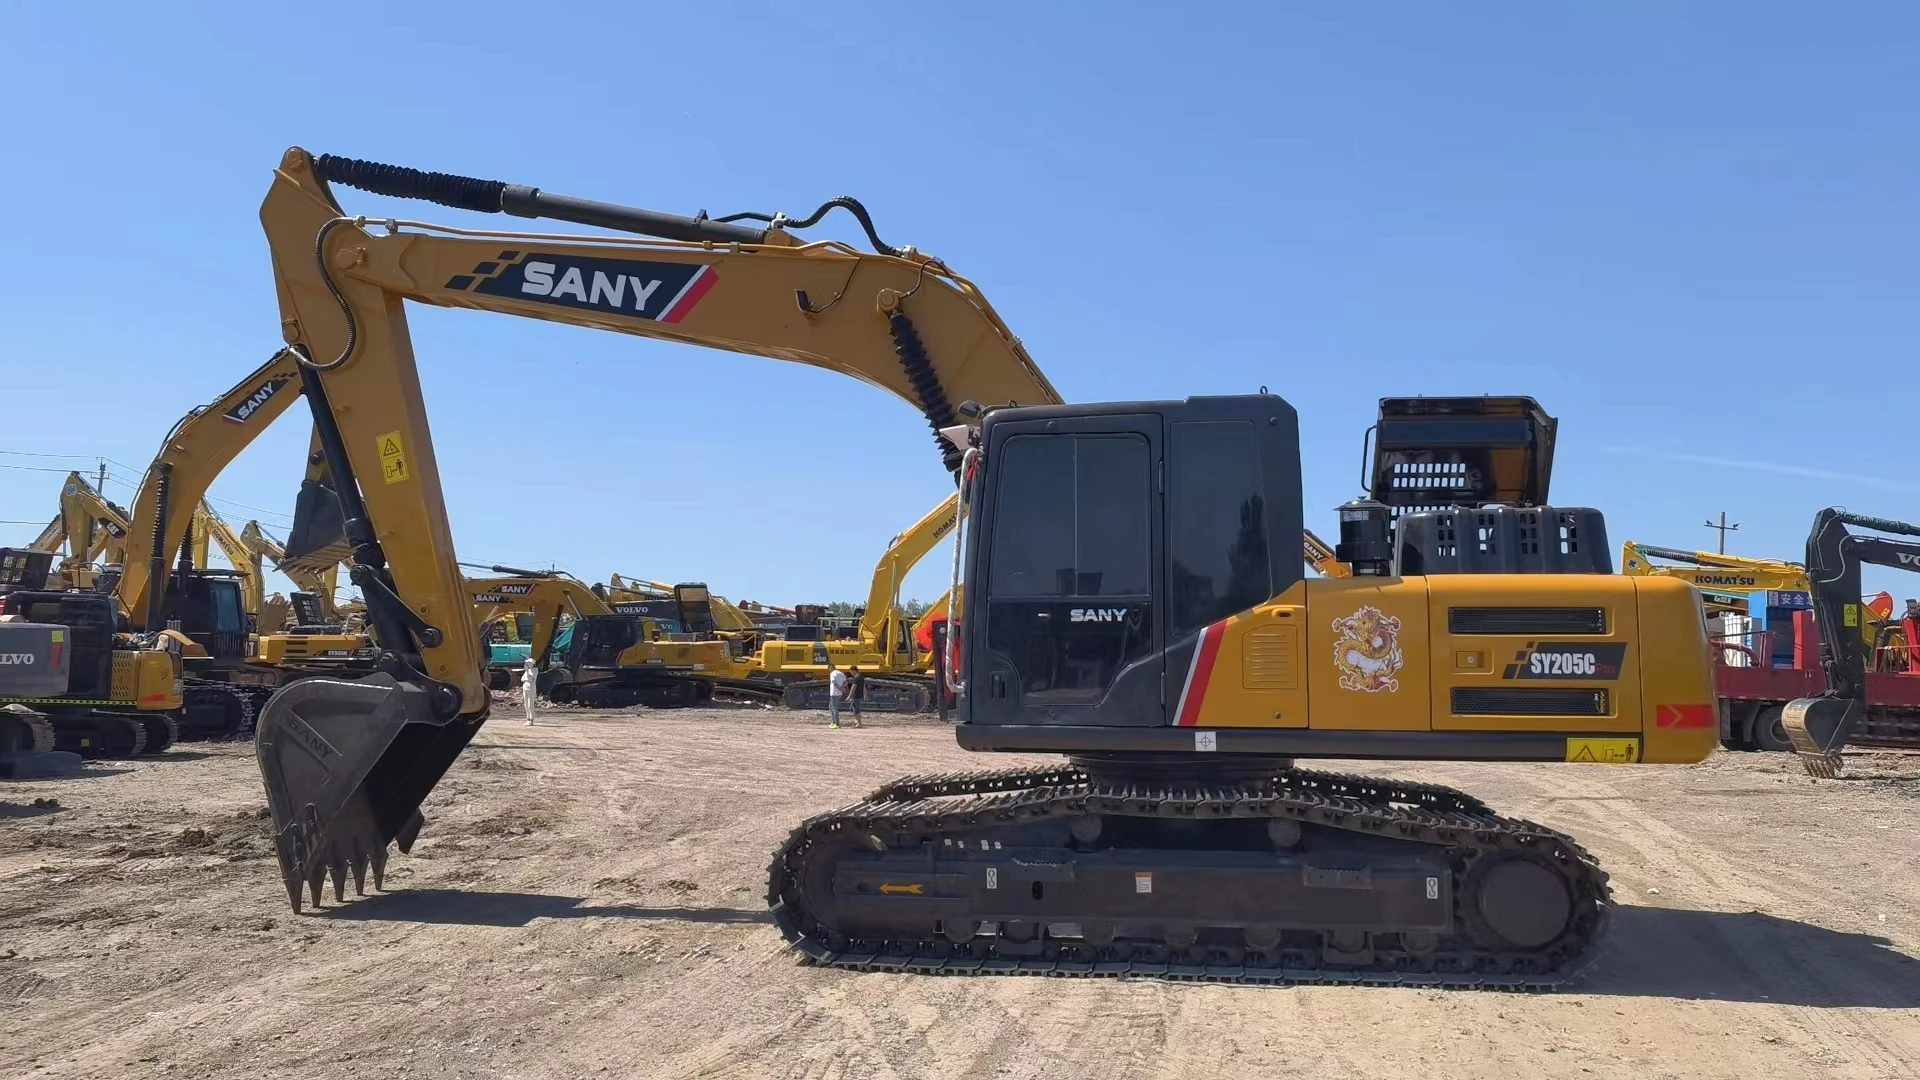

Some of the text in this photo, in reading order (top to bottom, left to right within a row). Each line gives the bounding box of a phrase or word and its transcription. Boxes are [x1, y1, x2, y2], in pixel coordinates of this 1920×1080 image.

[521, 261, 662, 311] SANY
[238, 381, 274, 420] SANY
[106, 521, 119, 535] CAT
[212, 528, 235, 556] KOMATSU
[1695, 575, 1755, 586] KOMATSU
[501, 583, 528, 594] SANY
[475, 594, 501, 603] SANY
[615, 606, 649, 614] VOLVO
[1070, 608, 1128, 622] SANY
[1530, 652, 1596, 674] SY205C
